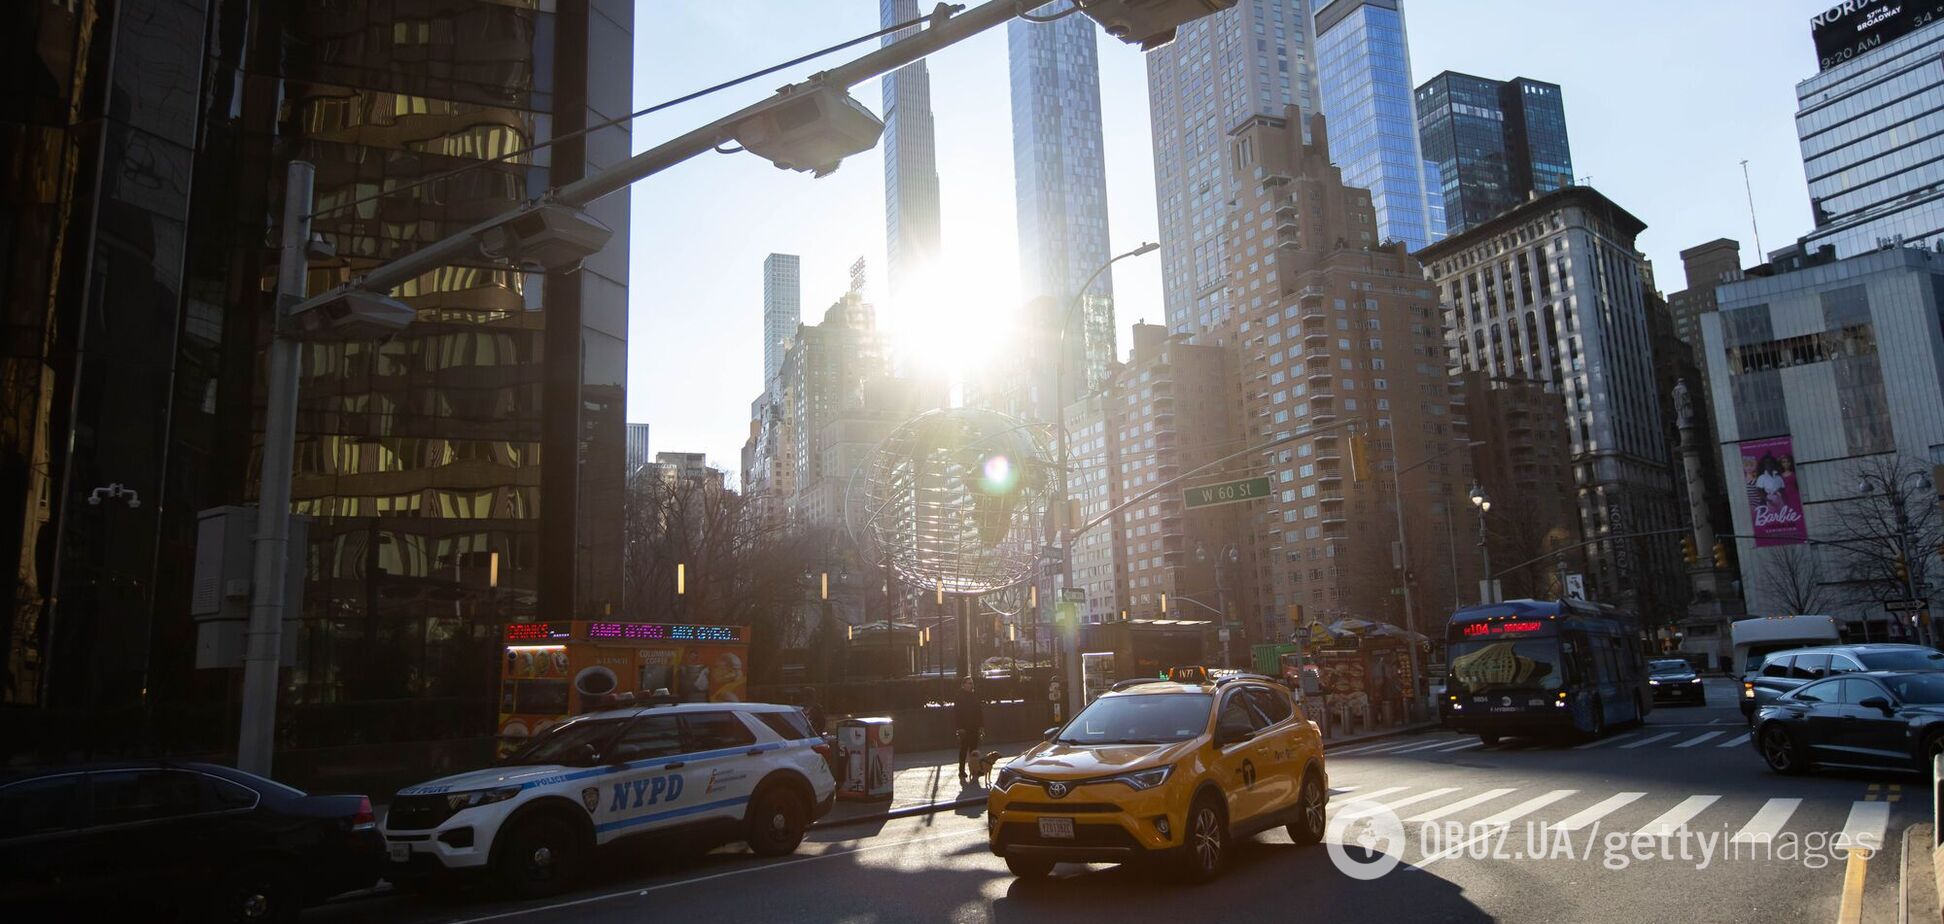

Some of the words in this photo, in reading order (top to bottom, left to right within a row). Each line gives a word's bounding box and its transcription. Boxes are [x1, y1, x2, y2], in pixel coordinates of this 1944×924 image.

[1811, 0, 1877, 30] NORD
[1857, 6, 1901, 31] BROADWAY
[1821, 47, 1853, 69] 9:20
[1857, 34, 1881, 53] AM
[1202, 489, 1213, 502] W
[1219, 486, 1234, 499] 60
[1240, 483, 1251, 497] St
[1755, 504, 1801, 526] Barbie
[672, 625, 693, 640] MIX
[534, 775, 567, 787] POLICE
[610, 774, 684, 812] NYPD
